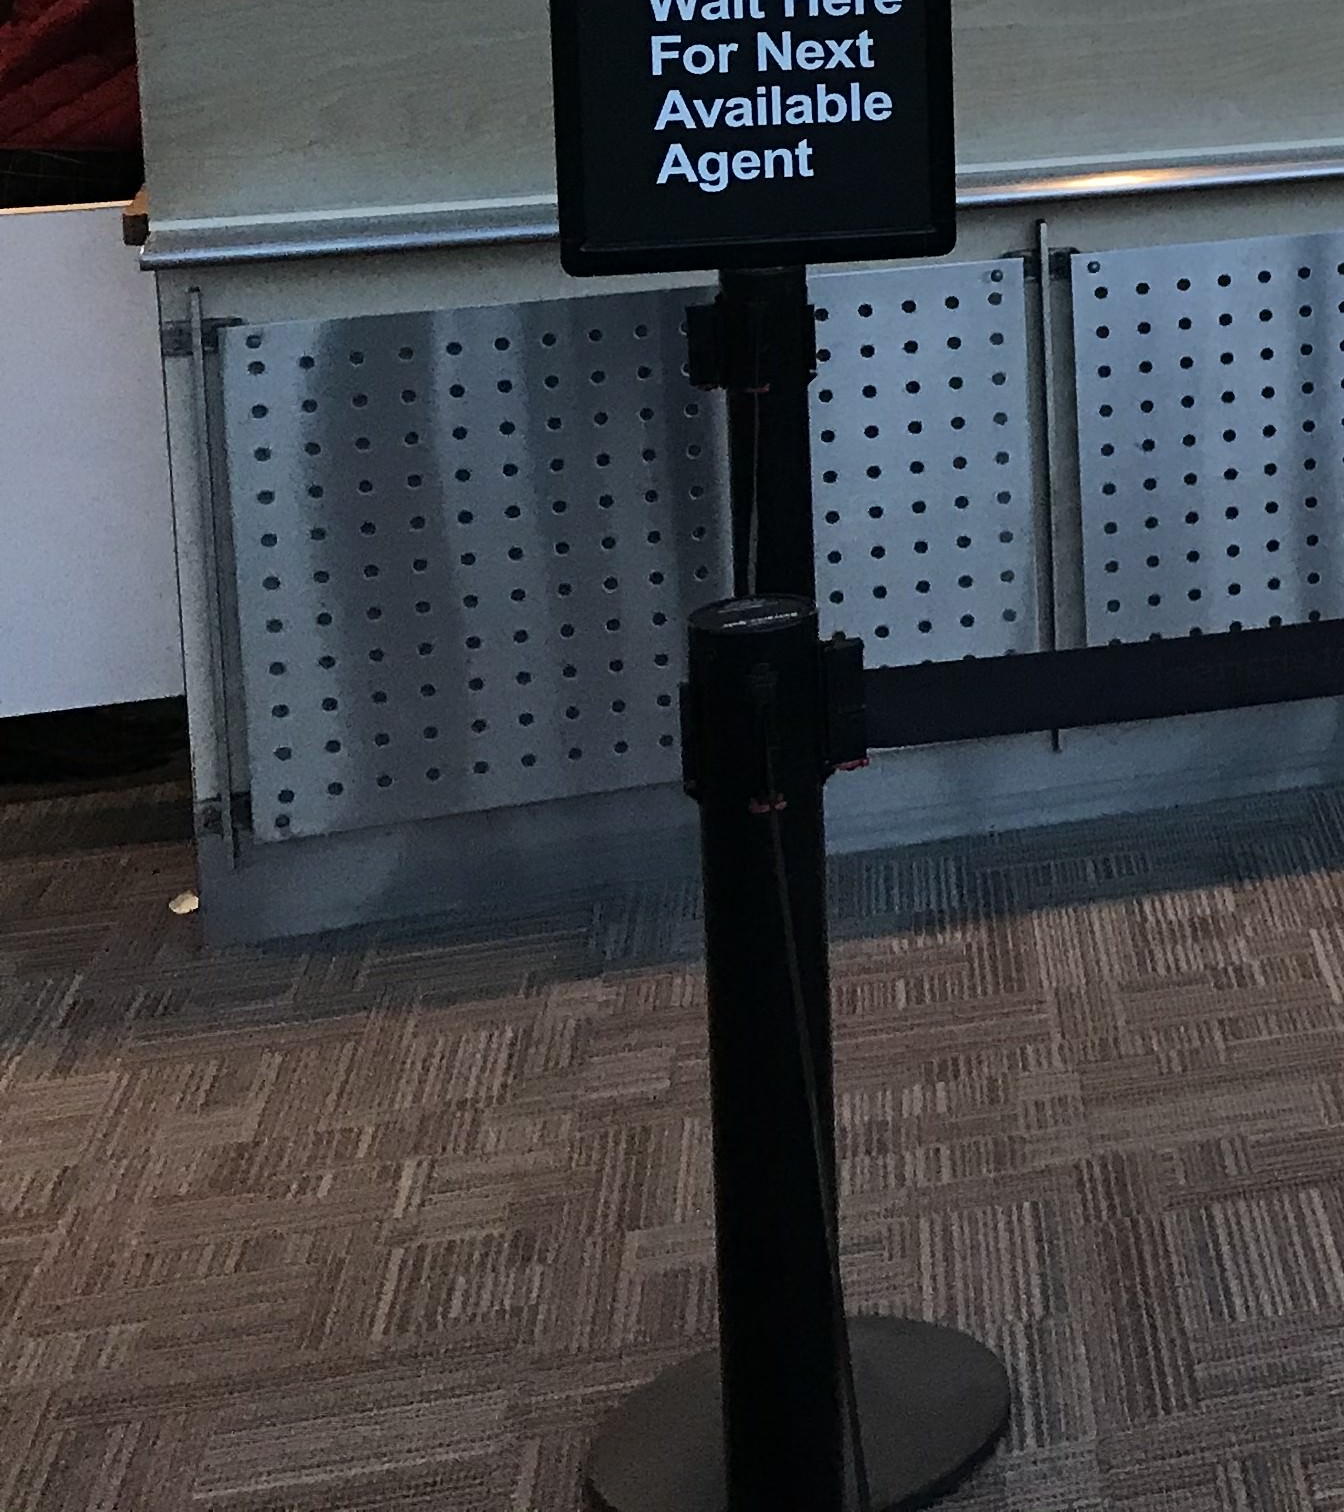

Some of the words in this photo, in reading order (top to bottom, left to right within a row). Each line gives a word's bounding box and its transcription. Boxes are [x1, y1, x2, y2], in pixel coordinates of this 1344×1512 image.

[651, 34, 739, 76] For
[757, 29, 875, 72] Next
[653, 82, 893, 131] Available
[656, 138, 815, 193] Agent
